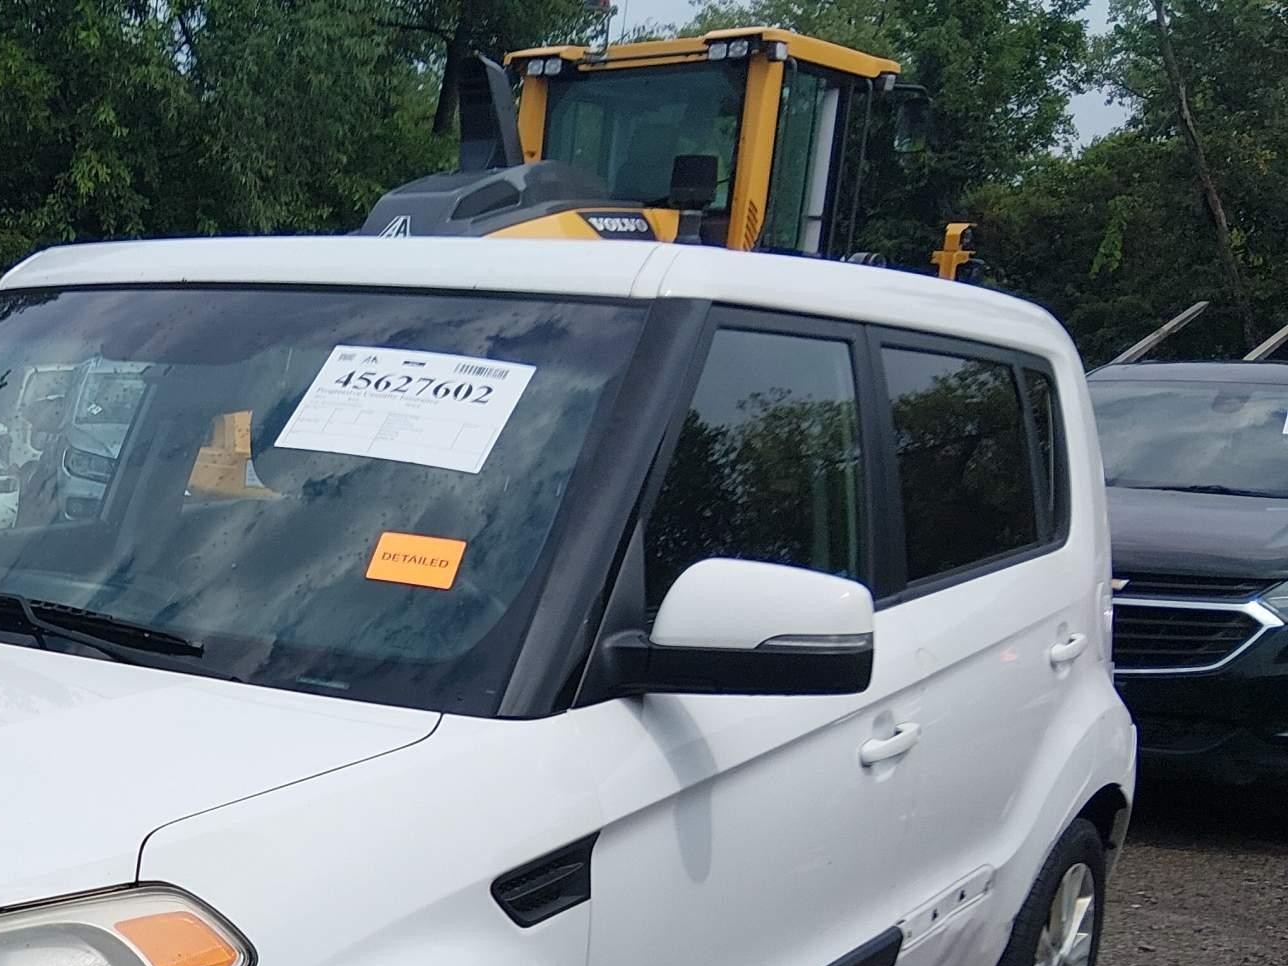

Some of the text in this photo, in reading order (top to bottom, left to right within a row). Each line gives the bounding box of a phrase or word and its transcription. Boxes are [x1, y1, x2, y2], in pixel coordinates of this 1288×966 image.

[588, 217, 649, 233] VOLVO
[334, 370, 494, 405] 45627602
[381, 551, 450, 569] DETAILED
